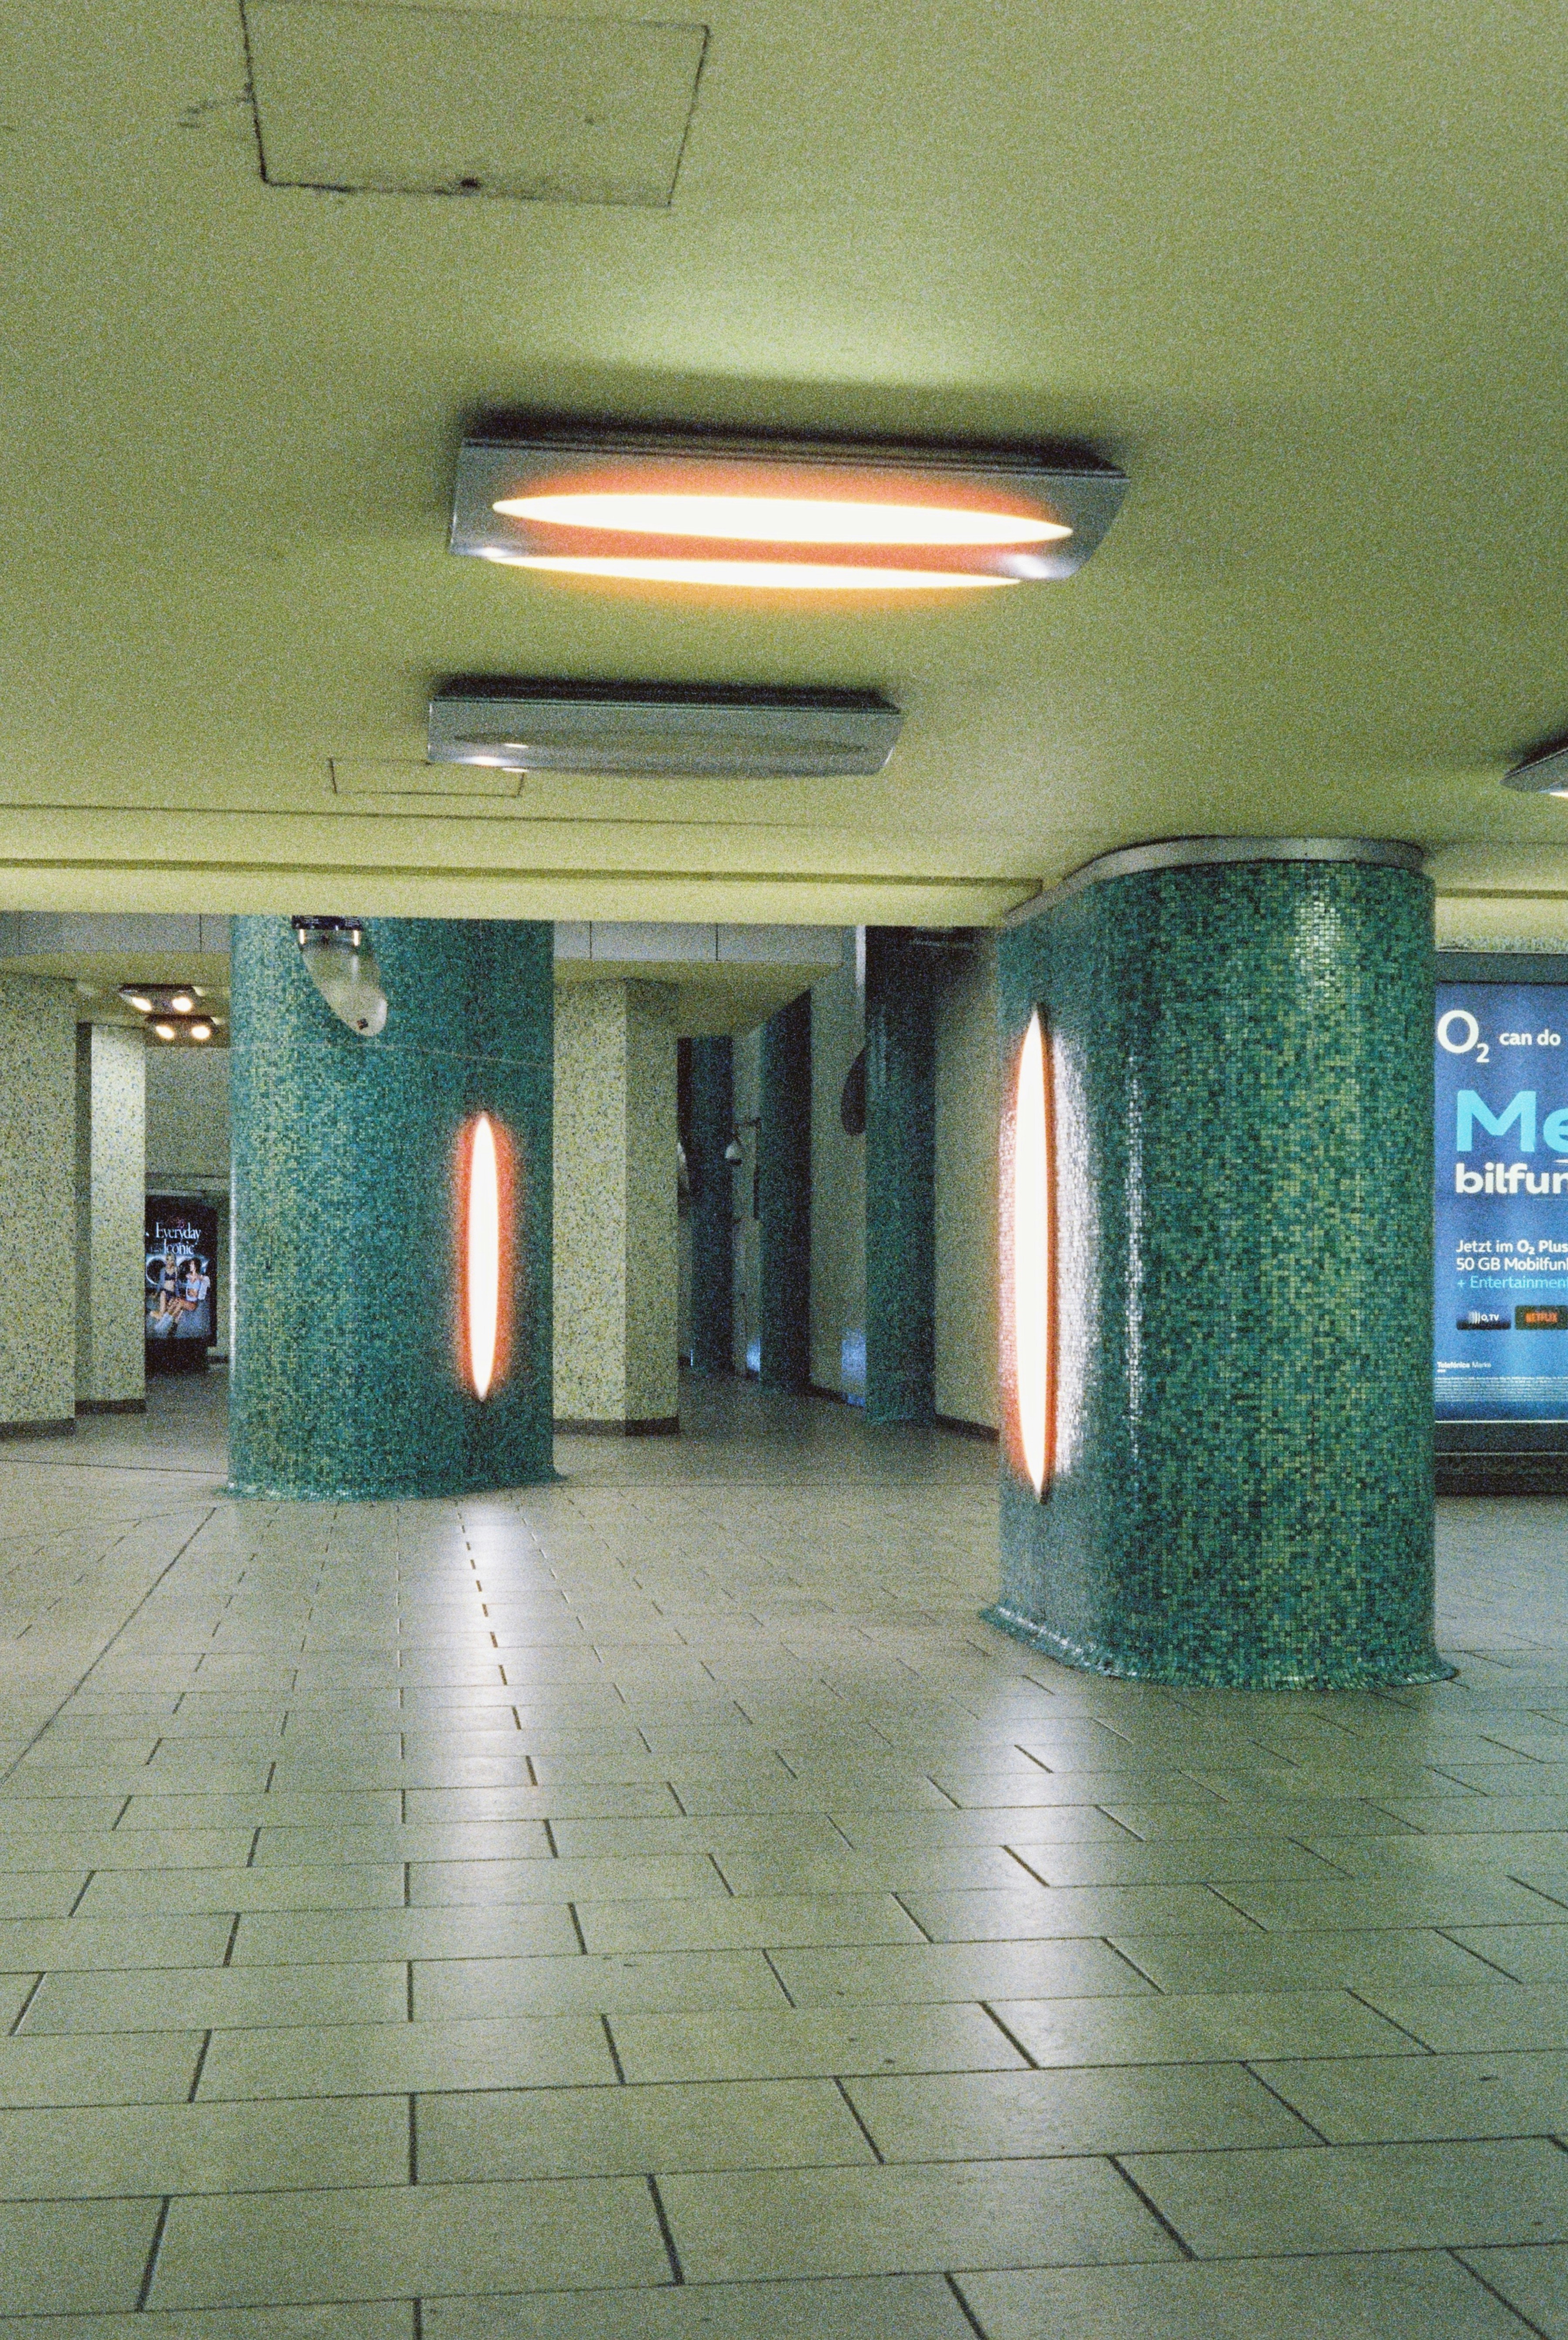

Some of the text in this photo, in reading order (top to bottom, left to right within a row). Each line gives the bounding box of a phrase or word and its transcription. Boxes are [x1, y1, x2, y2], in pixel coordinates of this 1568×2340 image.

[1438, 1010, 1561, 1063] O2 can do
[1456, 1162, 1568, 1194] bilfun
[156, 1222, 201, 1245] Everyday
[164, 1238, 194, 1255] Iconic
[1456, 1239, 1568, 1255] Jetzt im O2 Plus
[1456, 1257, 1475, 1271] 50
[1478, 1257, 1500, 1271] GB
